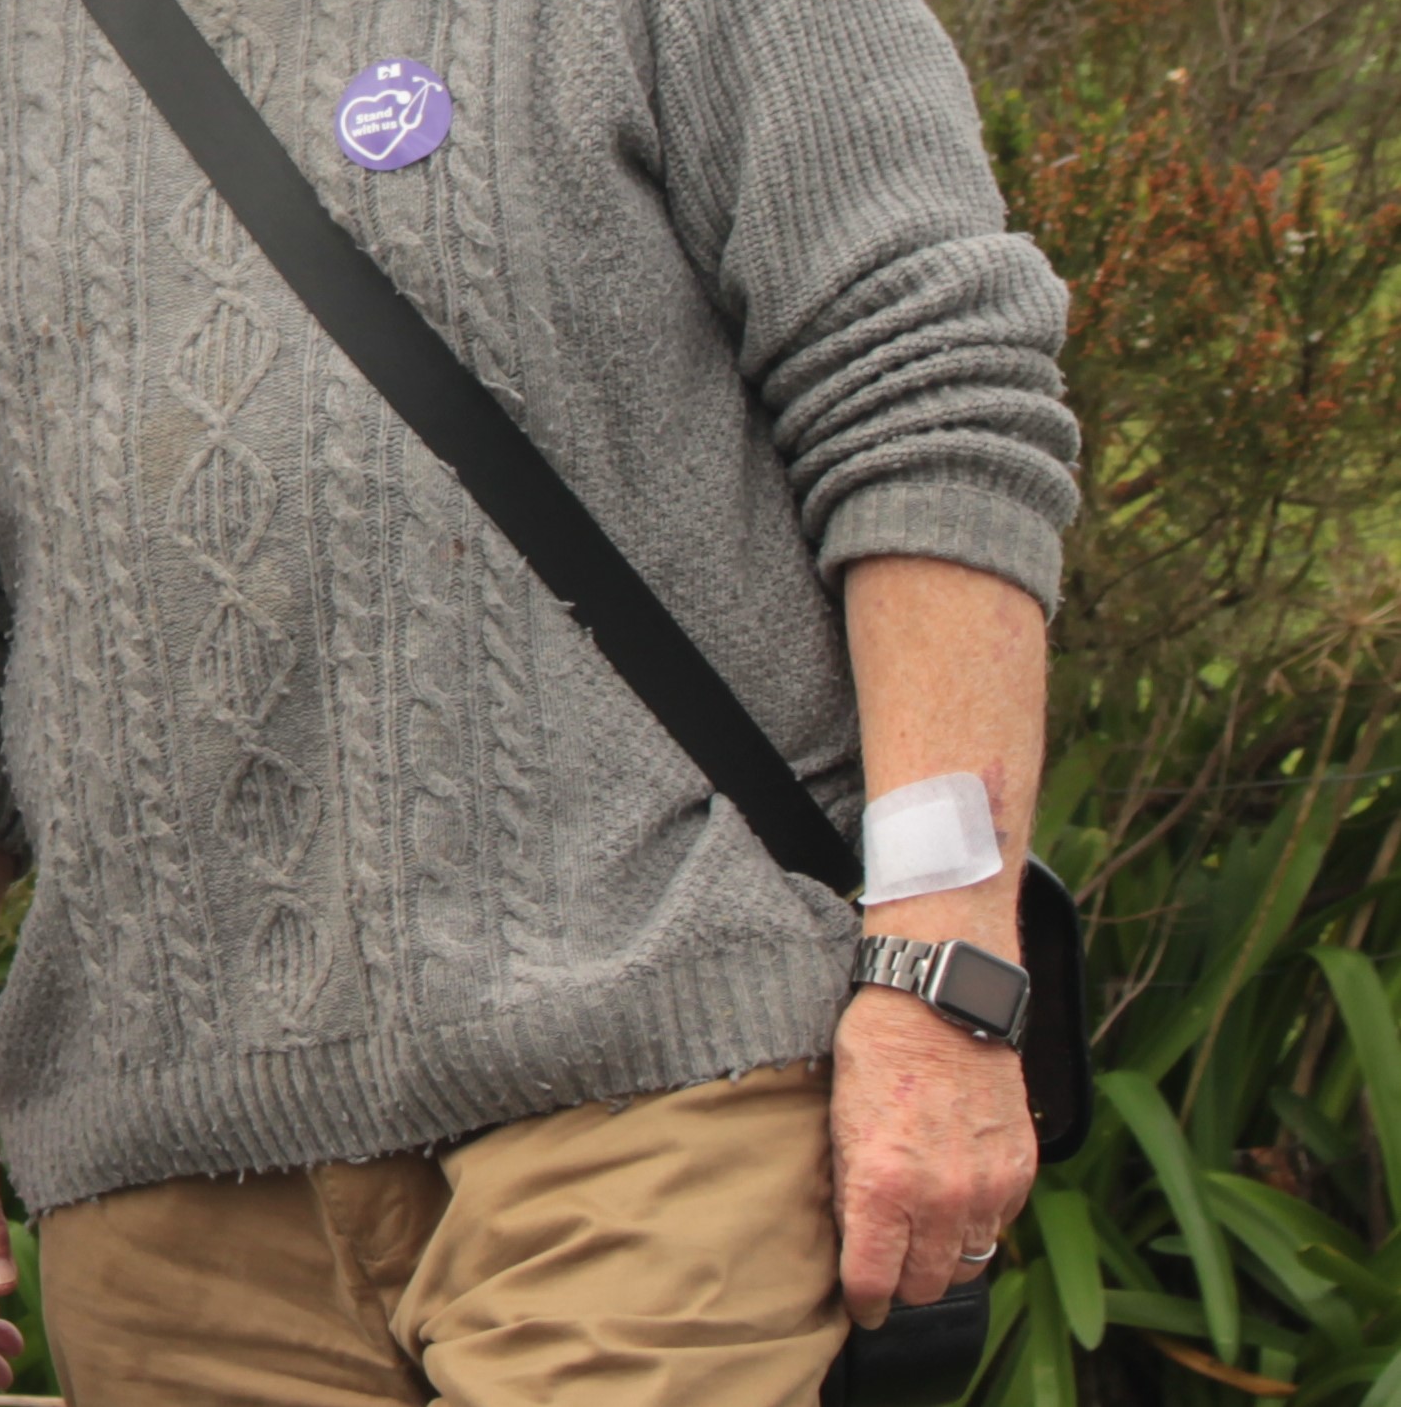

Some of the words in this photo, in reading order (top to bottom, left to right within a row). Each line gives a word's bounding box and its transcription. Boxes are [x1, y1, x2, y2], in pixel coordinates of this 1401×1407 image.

[355, 106, 393, 125] Stand
[351, 122, 380, 138] with
[381, 120, 398, 131] us
